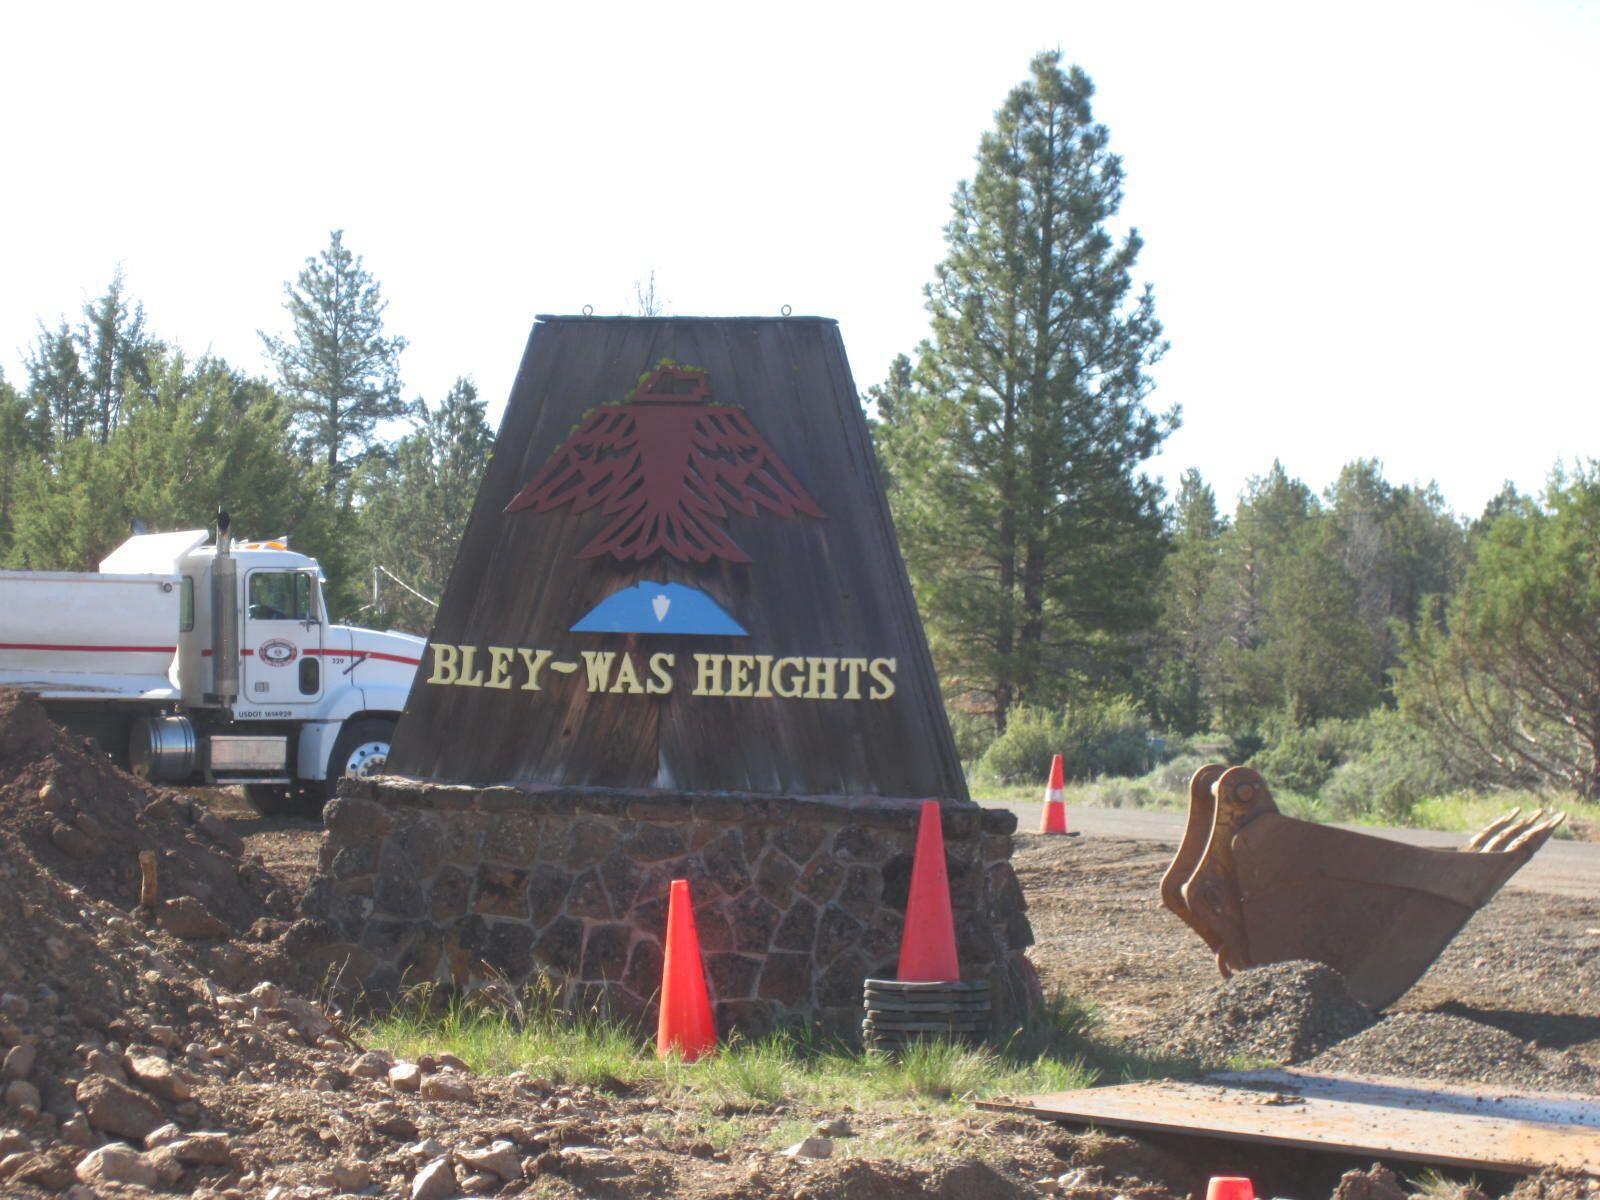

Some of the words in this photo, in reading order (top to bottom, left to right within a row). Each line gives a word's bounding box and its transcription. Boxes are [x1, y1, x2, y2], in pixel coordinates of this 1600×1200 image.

[427, 643, 675, 694] BLEY-WAS
[692, 653, 897, 700] HEIGHTS
[238, 710, 262, 718] USDOT
